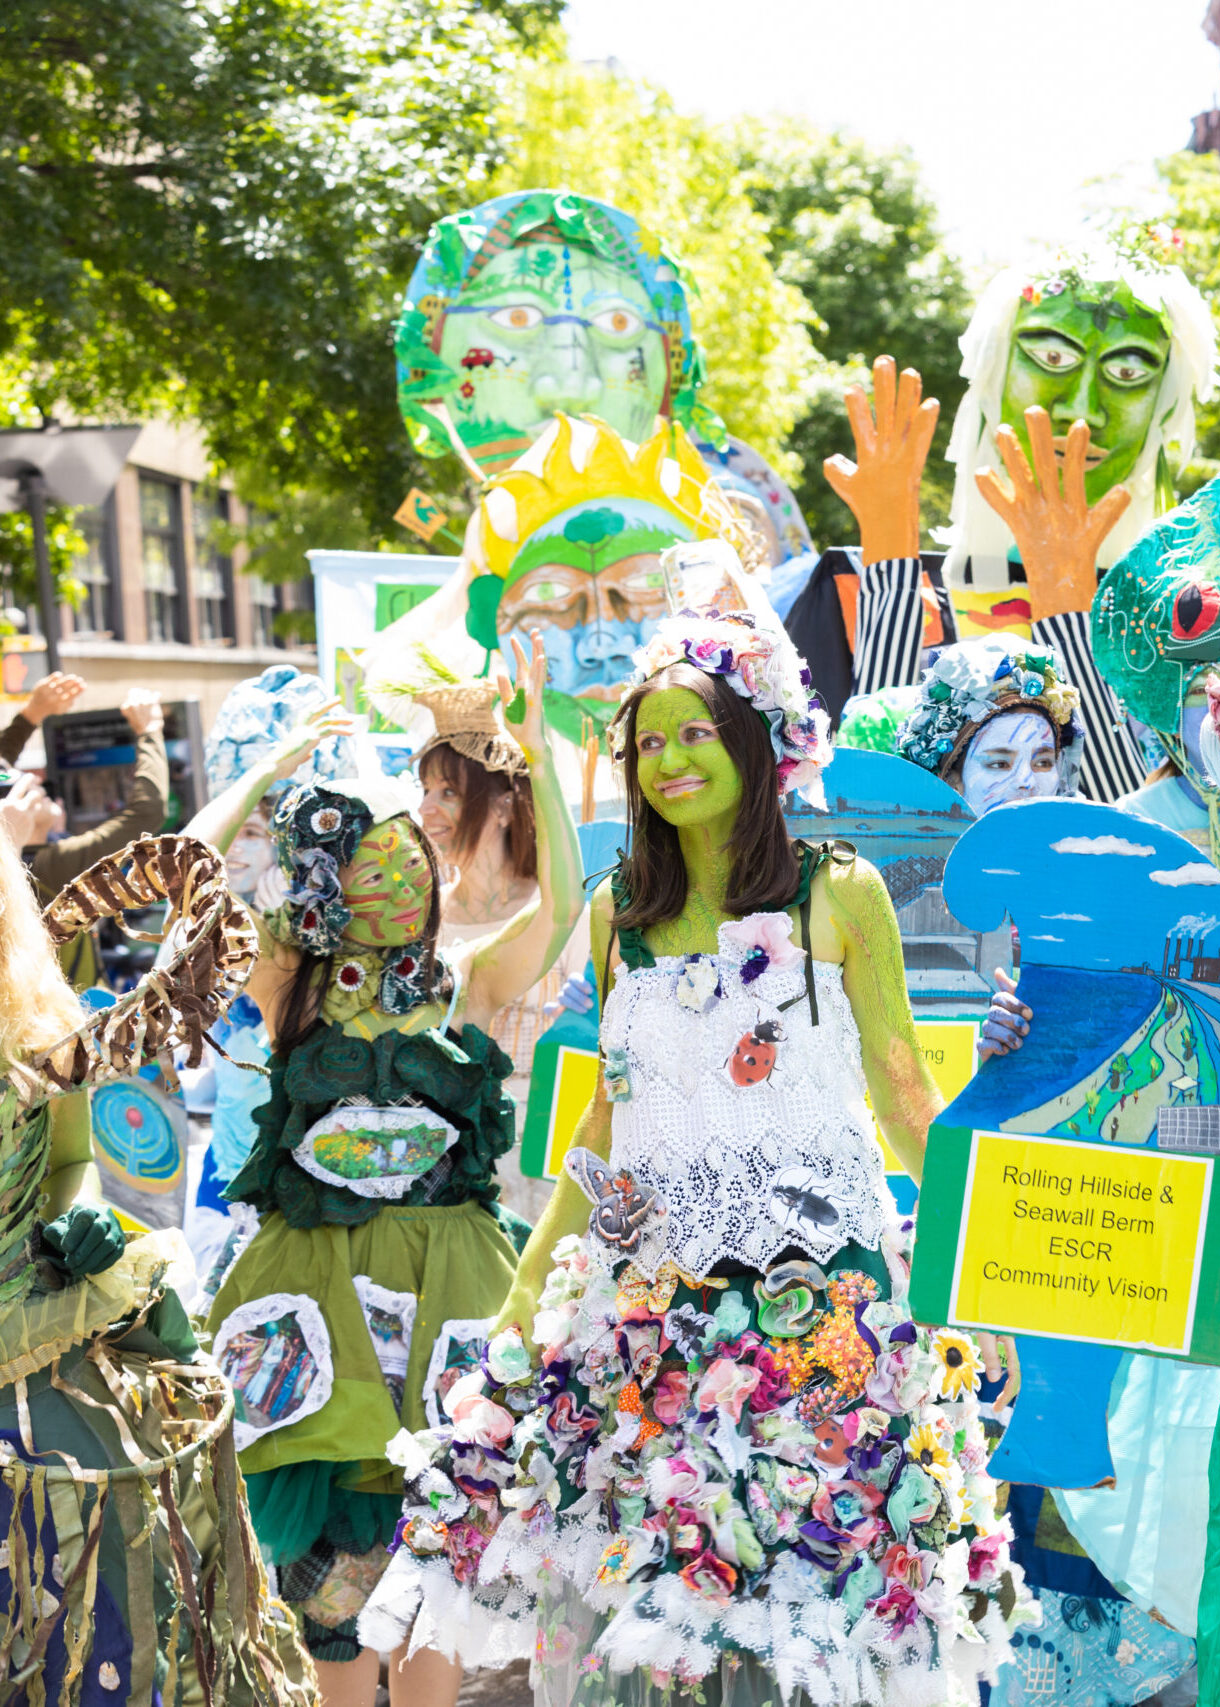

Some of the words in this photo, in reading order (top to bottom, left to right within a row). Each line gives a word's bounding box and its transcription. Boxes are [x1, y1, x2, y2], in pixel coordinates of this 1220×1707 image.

[1003, 1165, 1072, 1193] Rolling
[1080, 1175, 1152, 1202] Hillside
[1159, 1185, 1174, 1204] &
[1013, 1199, 1094, 1226] Seawall
[1101, 1210, 1155, 1234] Berm
[1049, 1236, 1112, 1262] ESCR
[983, 1260, 1100, 1297] Community
[1106, 1277, 1168, 1302] Vision
